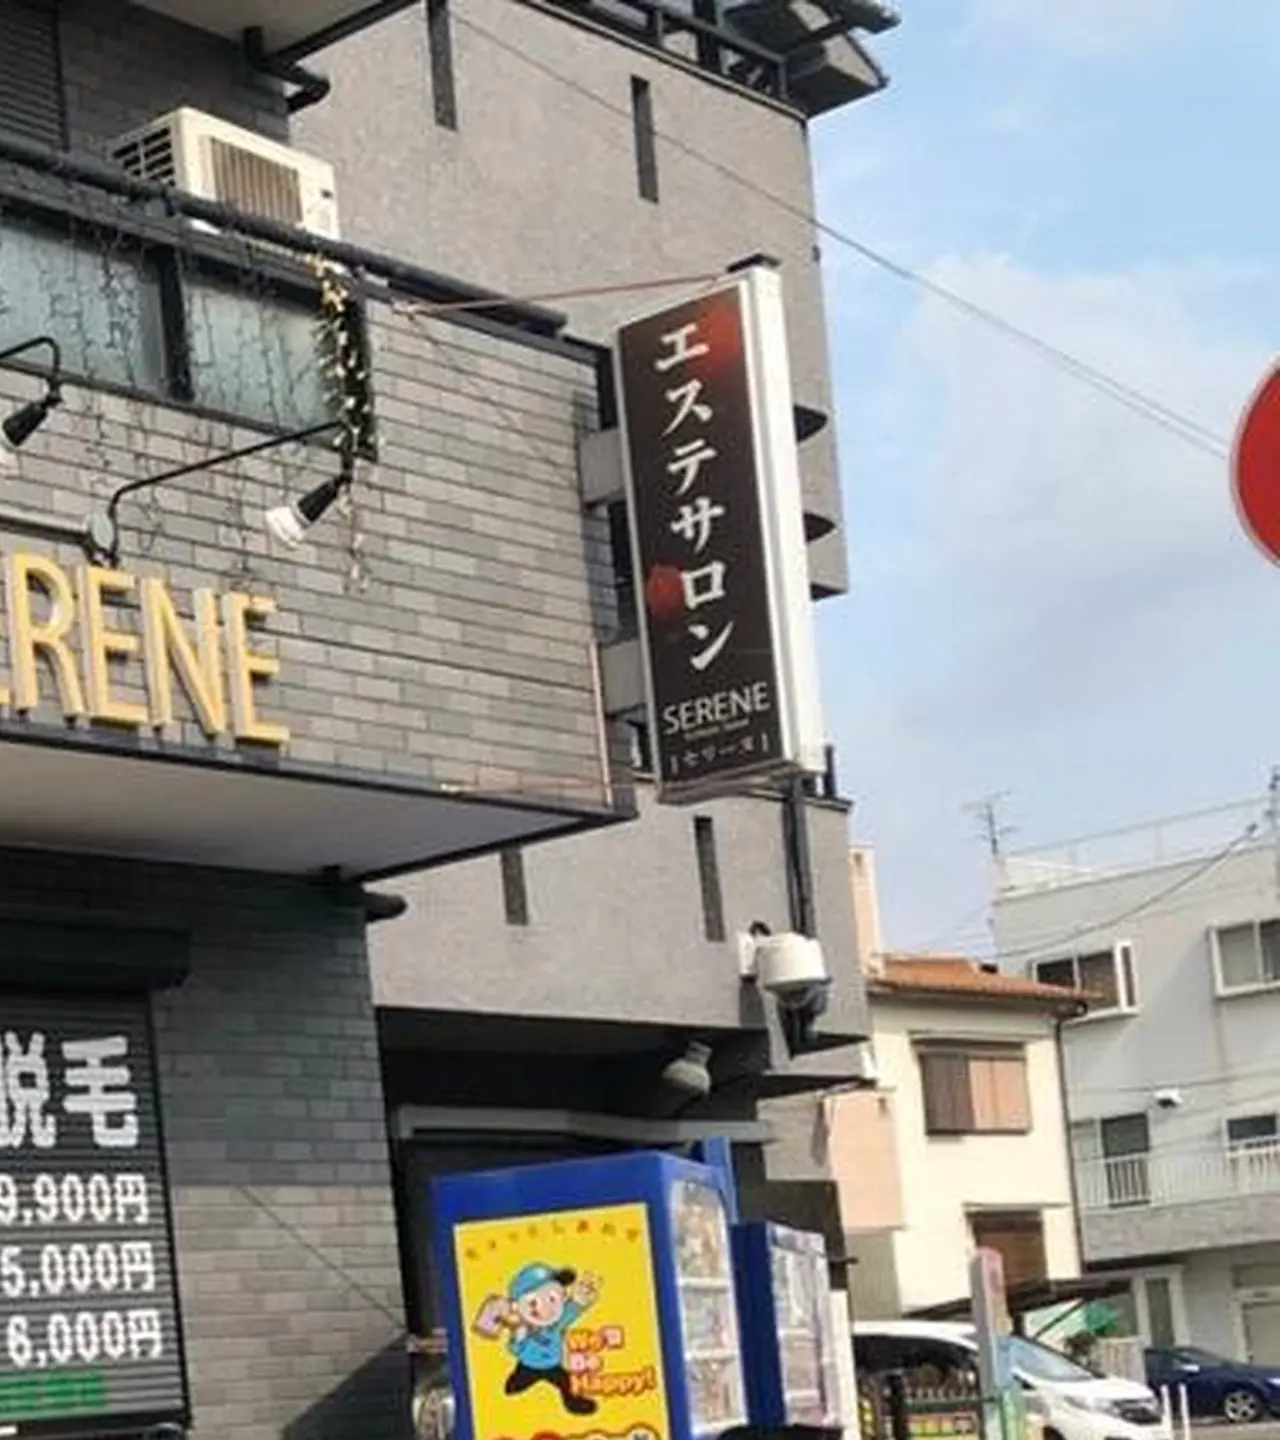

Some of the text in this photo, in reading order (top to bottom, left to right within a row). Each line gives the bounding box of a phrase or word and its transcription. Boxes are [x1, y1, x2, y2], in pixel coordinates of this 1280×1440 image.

[654, 321, 735, 671] エステサロン
[662, 680, 771, 735] SERENE
[569, 1366, 657, 1397] Happy!
